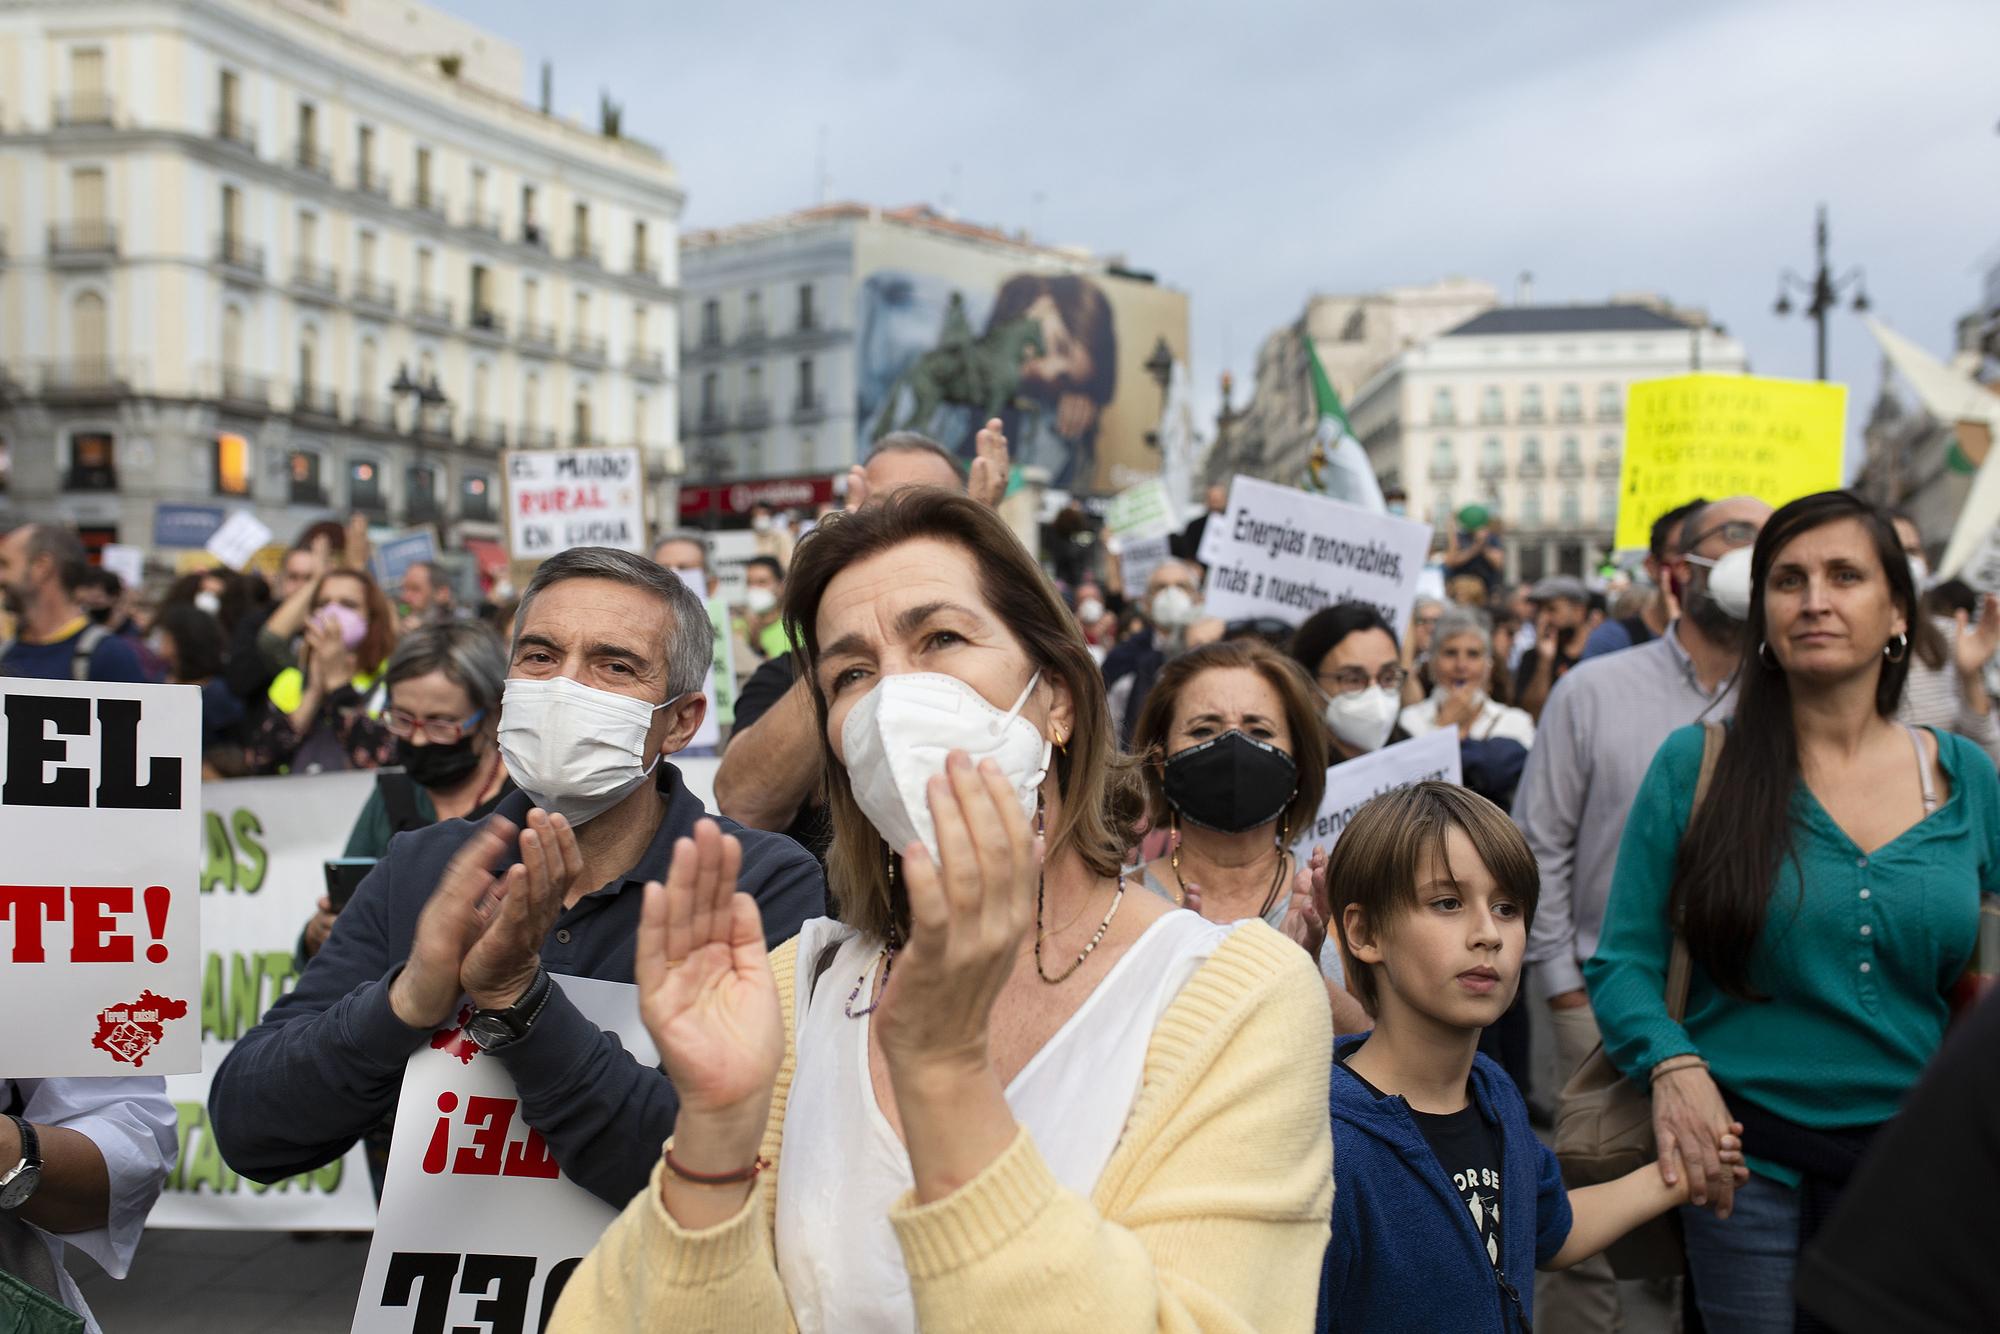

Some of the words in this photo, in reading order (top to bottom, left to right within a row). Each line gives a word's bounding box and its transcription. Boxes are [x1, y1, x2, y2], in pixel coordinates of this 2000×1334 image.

[510, 456, 538, 479] EL
[556, 455, 631, 480] MUNDO
[518, 484, 608, 516] RURAL
[522, 525, 553, 548] EN
[1232, 507, 1306, 557] Energías
[1307, 534, 1405, 588] renovables,
[1213, 561, 1250, 595] más
[1251, 573, 1264, 598] a
[2, 694, 182, 810] EL
[200, 808, 268, 894] AS
[0, 885, 171, 964] TE!
